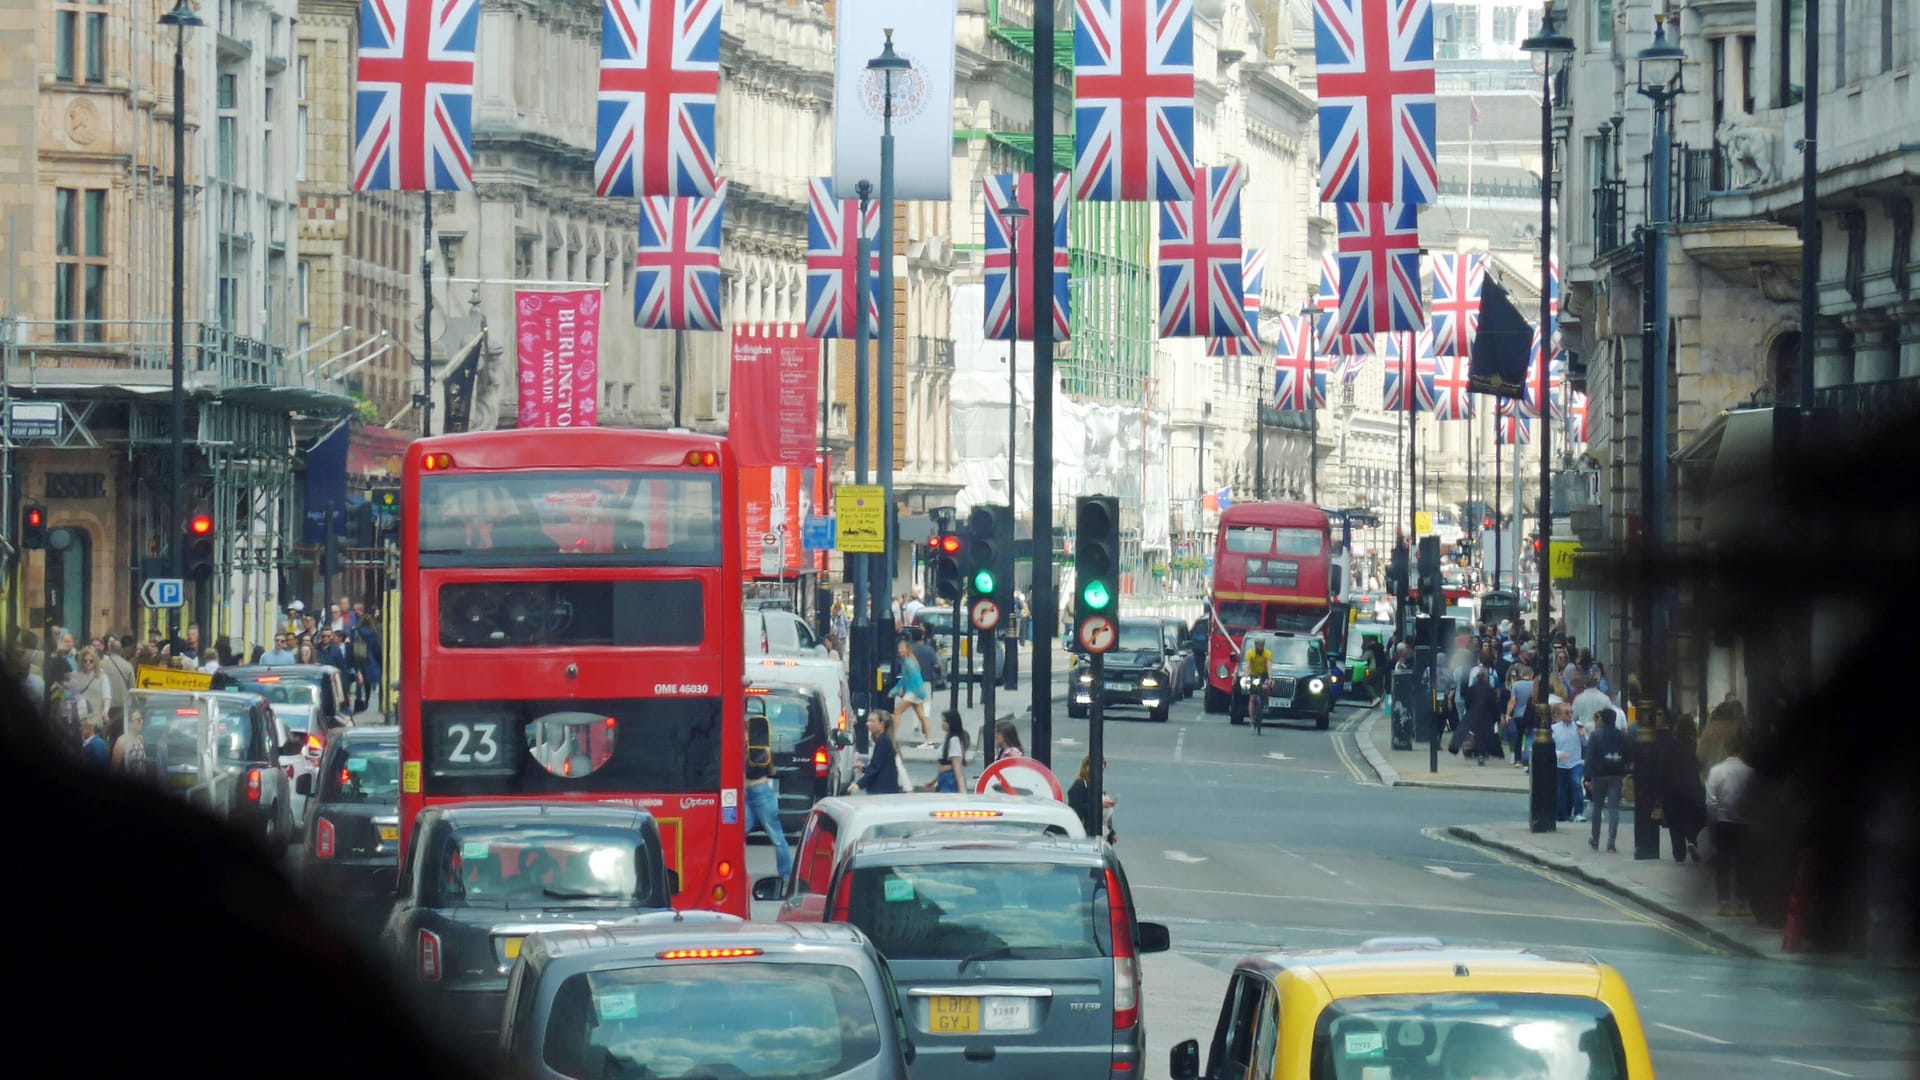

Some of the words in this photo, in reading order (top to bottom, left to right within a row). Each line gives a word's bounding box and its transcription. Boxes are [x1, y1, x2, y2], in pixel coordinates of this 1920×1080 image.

[542, 349, 555, 404] ARCADE
[557, 309, 576, 427] BURLINGTO
[163, 584, 177, 602] P
[654, 684, 677, 694] OME
[679, 684, 708, 694] 46030
[448, 724, 497, 763] 23
[939, 1015, 971, 1029] GYJ
